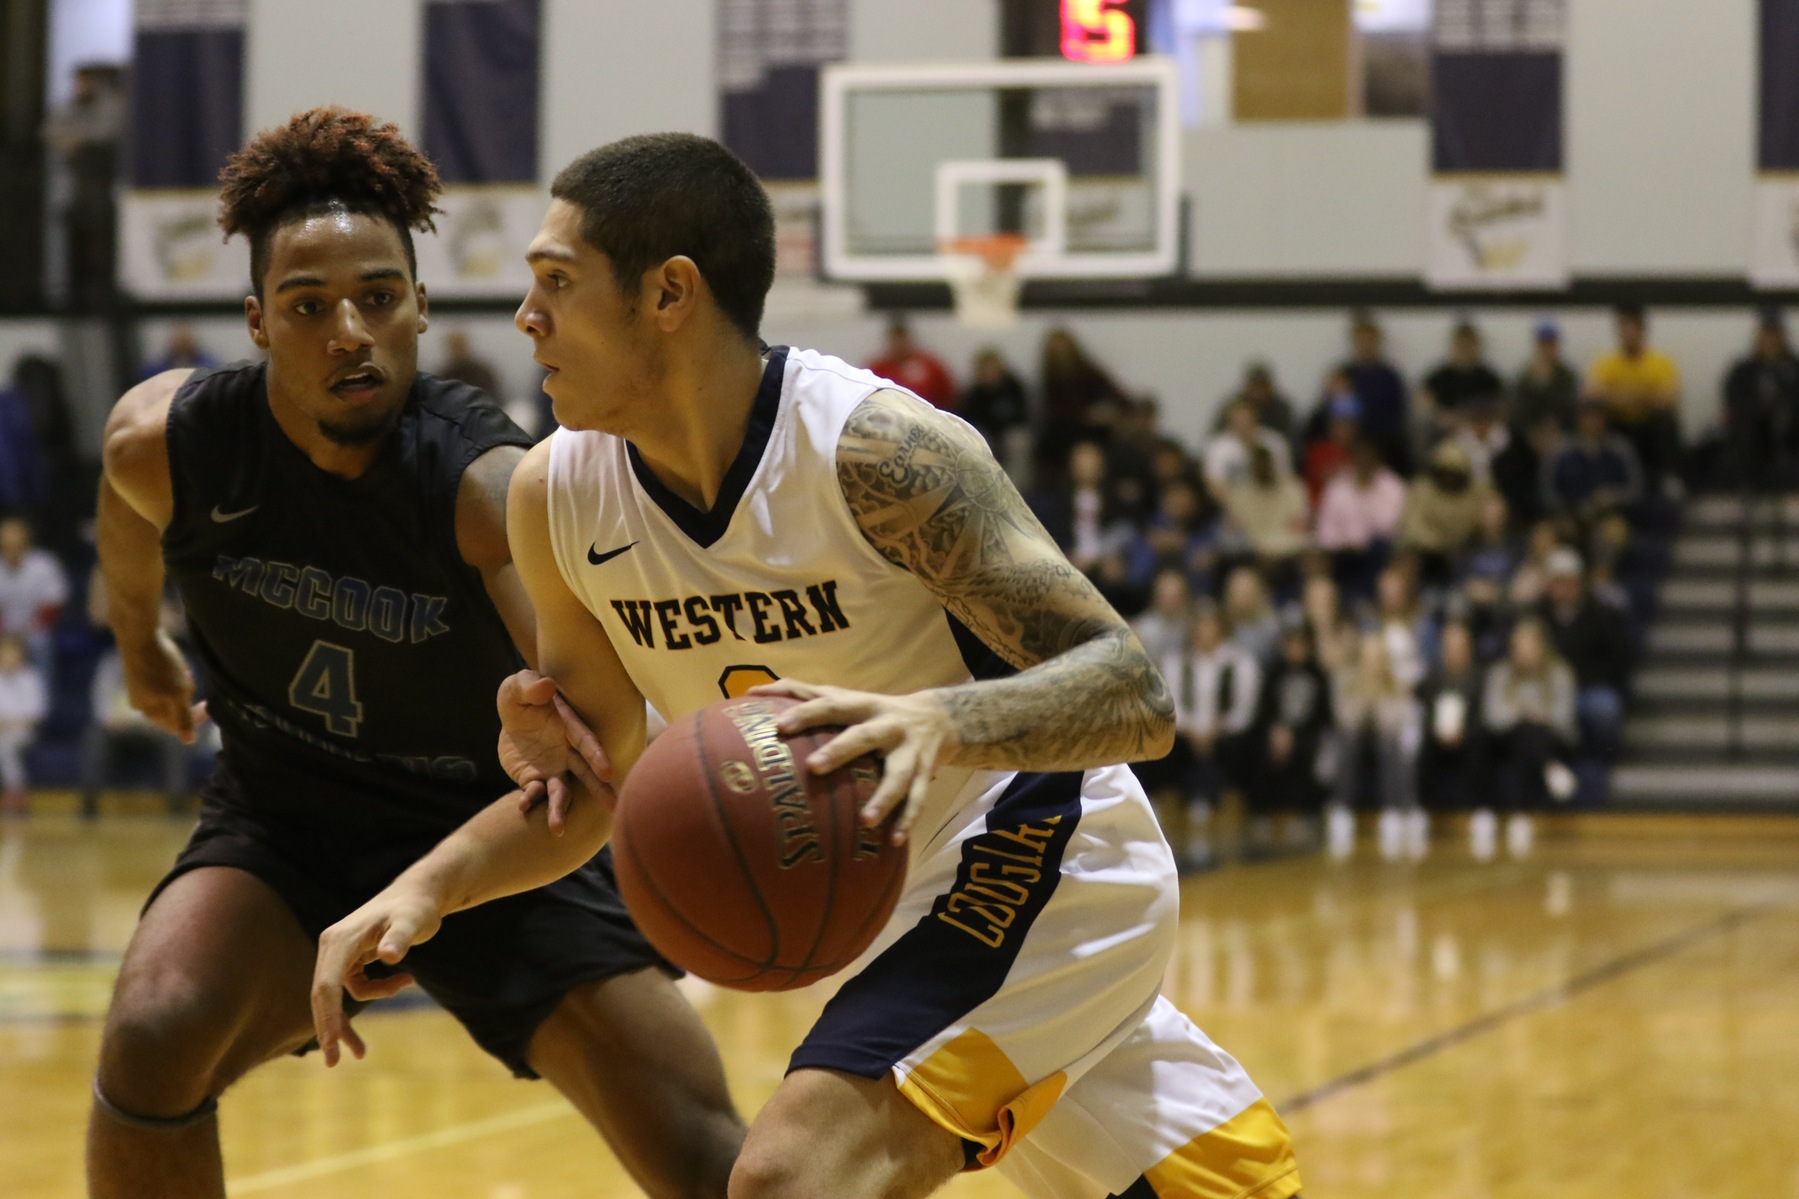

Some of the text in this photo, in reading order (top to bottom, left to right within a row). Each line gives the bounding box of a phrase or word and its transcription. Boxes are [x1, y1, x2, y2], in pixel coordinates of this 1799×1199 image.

[609, 579, 851, 650] WESTERN
[287, 639, 364, 738] 4
[720, 700, 826, 869] SPALDING
